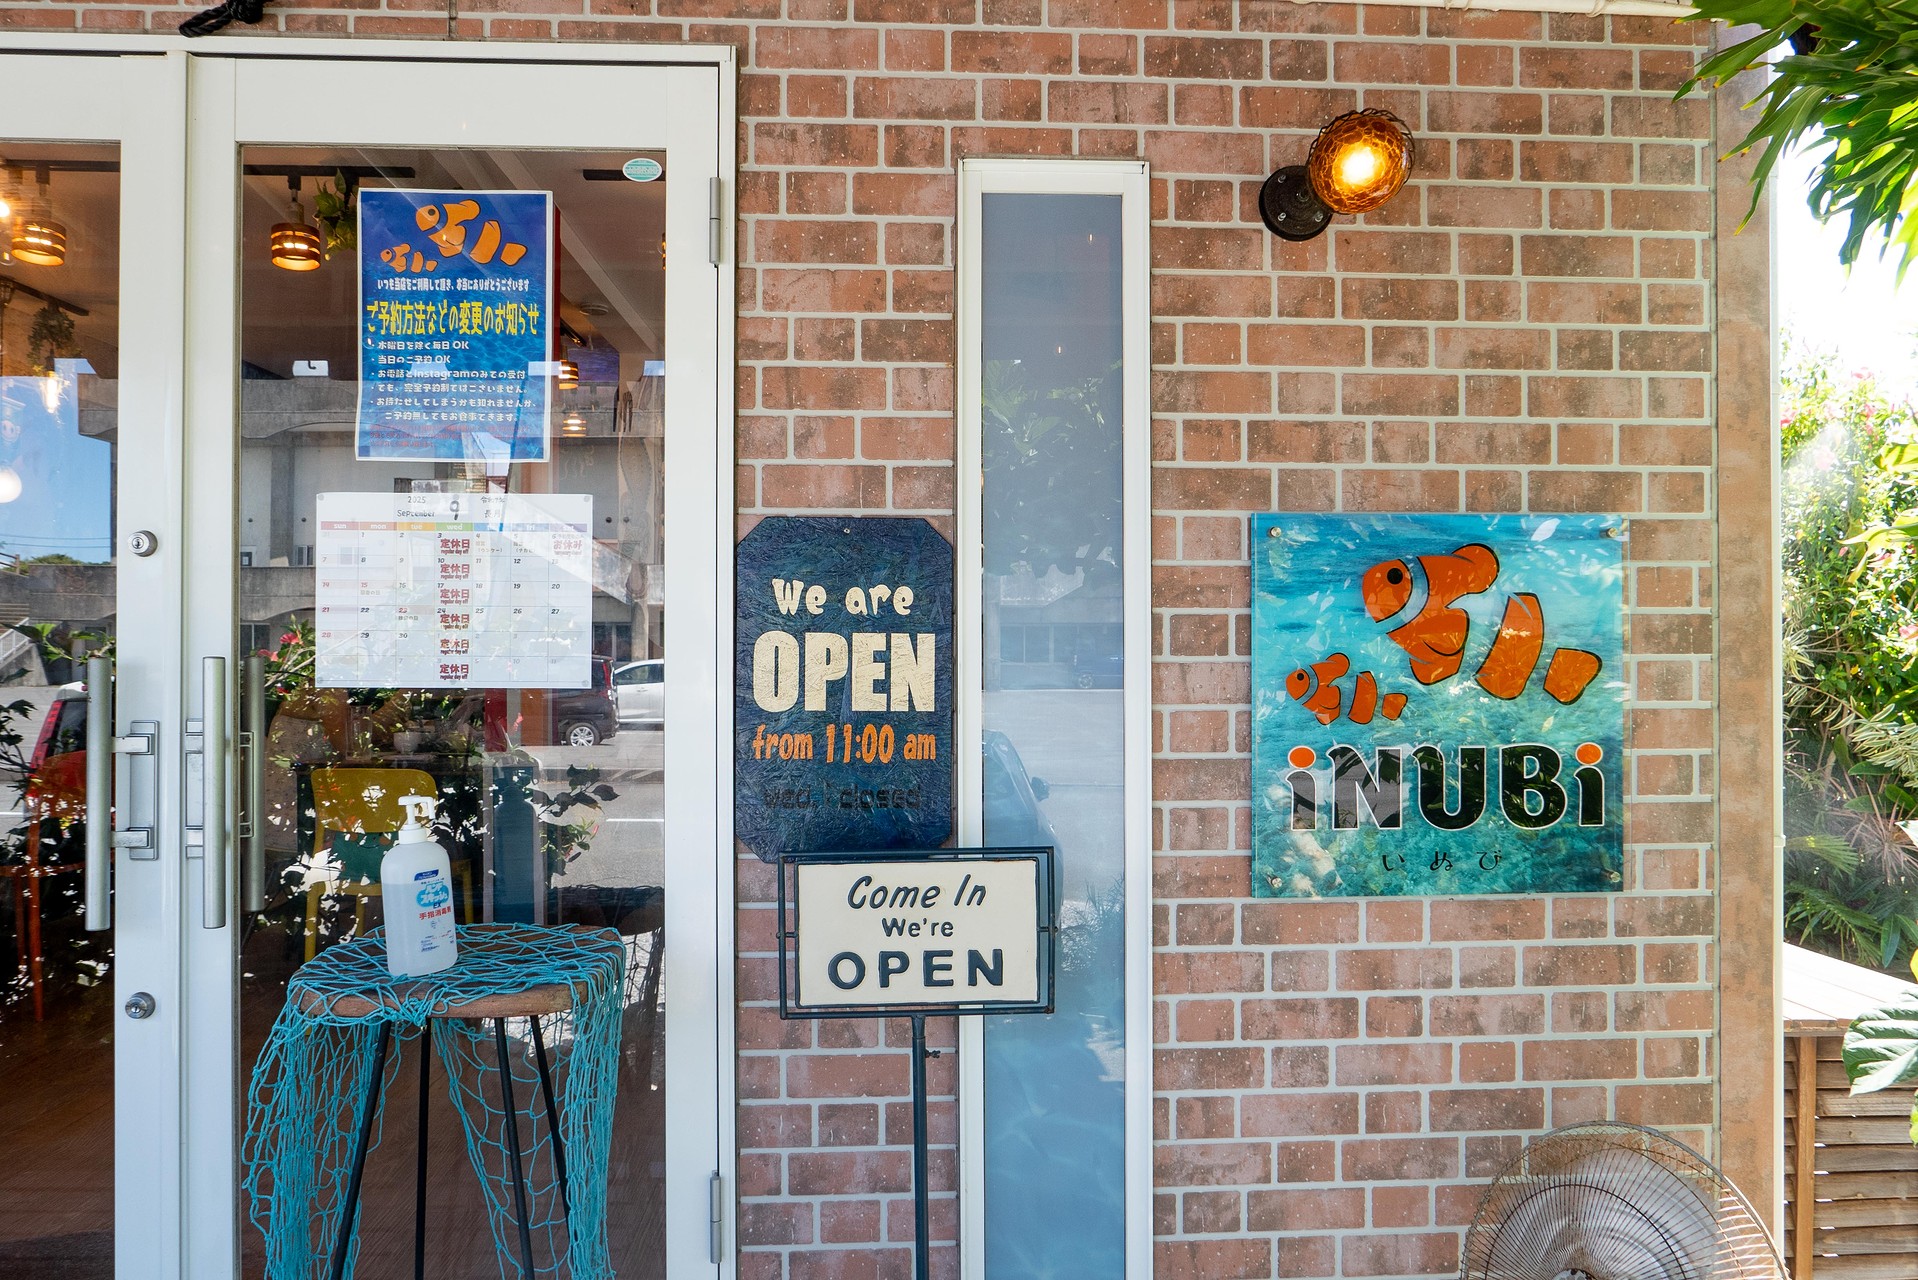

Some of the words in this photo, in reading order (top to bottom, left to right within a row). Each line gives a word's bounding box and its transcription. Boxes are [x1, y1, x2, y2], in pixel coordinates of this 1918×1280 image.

[366, 300, 540, 336] ご予約方法などの変更のお知らせ
[378, 342, 450, 350] 水曜日を除く毎日
[452, 341, 470, 350] OK
[378, 356, 432, 364] 当日のご予約
[434, 356, 450, 364] OK
[408, 496, 426, 504] 2025
[450, 500, 460, 520] 9
[440, 538, 470, 548] 定休日
[554, 540, 582, 550] お休み
[440, 564, 470, 573] 定休日
[440, 589, 470, 598] 定休日
[772, 578, 828, 616] We
[844, 584, 914, 616] are
[440, 614, 469, 623] 定休日
[440, 639, 469, 649] 定休日
[440, 664, 469, 674] 定休日
[752, 630, 936, 713] OPEN
[752, 724, 813, 761] from
[826, 723, 894, 764] 11:00
[903, 733, 936, 760] am
[847, 875, 940, 909] Come
[953, 874, 986, 906] In
[881, 918, 954, 937] We're
[827, 948, 1003, 990] OPEN
